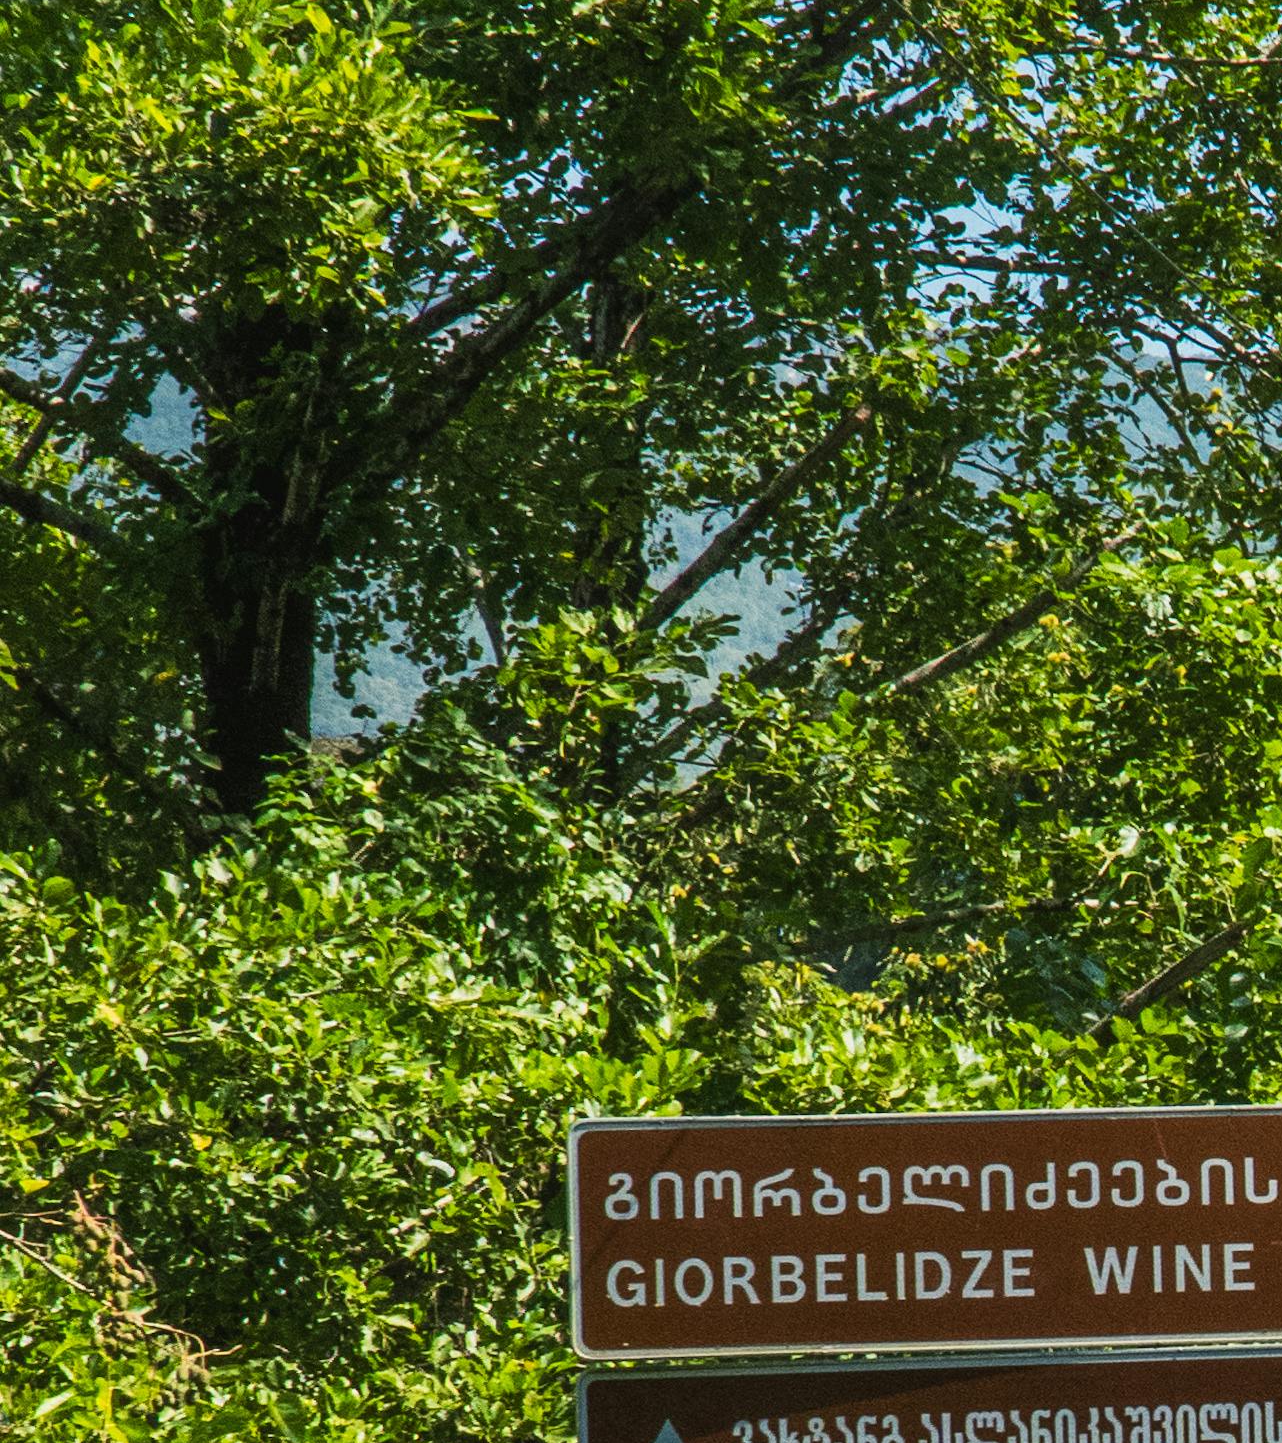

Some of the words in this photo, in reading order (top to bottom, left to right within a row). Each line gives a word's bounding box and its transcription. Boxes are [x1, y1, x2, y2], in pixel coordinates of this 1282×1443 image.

[605, 1157, 1278, 1220] გიორბელიძეების
[607, 1249, 1035, 1307] GIORBELIDZE
[1084, 1243, 1255, 1295] WINE
